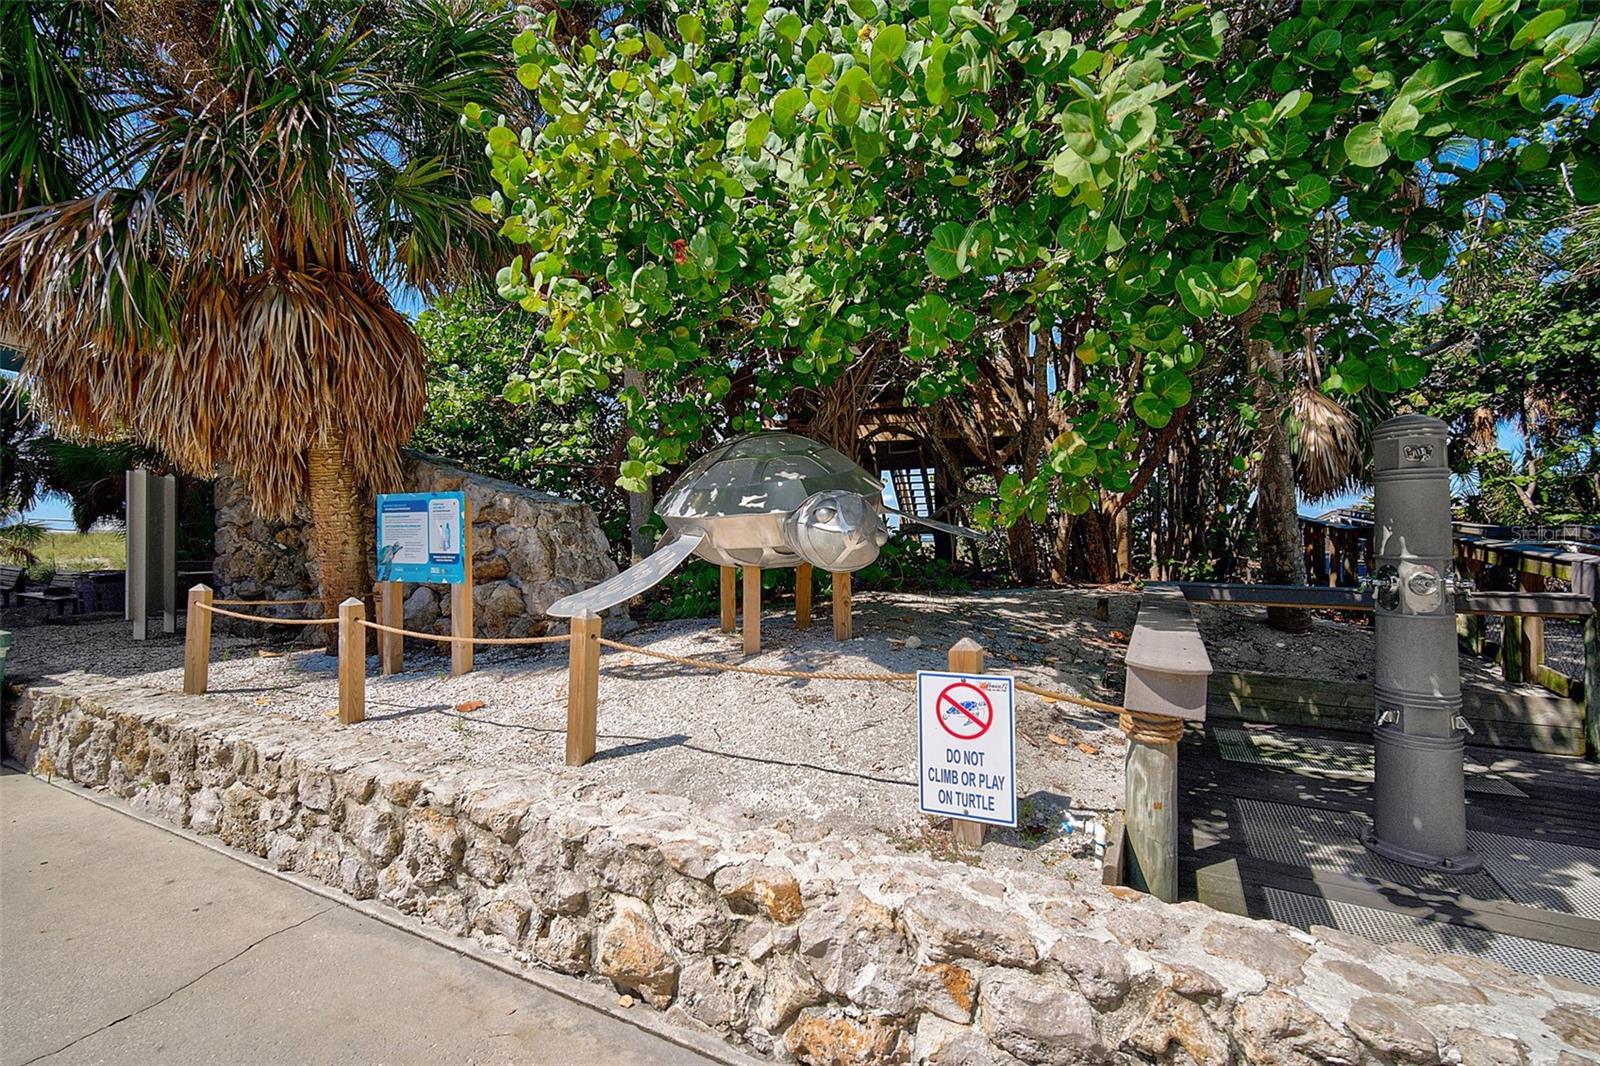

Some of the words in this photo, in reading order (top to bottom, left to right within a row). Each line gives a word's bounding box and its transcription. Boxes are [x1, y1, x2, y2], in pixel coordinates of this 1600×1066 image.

[947, 749, 961, 764] DO
[964, 750, 985, 767] NOT
[928, 767, 958, 785] CLIMB
[961, 771, 976, 787] OR
[979, 773, 1005, 791] PLAY
[938, 789, 953, 805] ON
[955, 791, 995, 811] TURTLE
